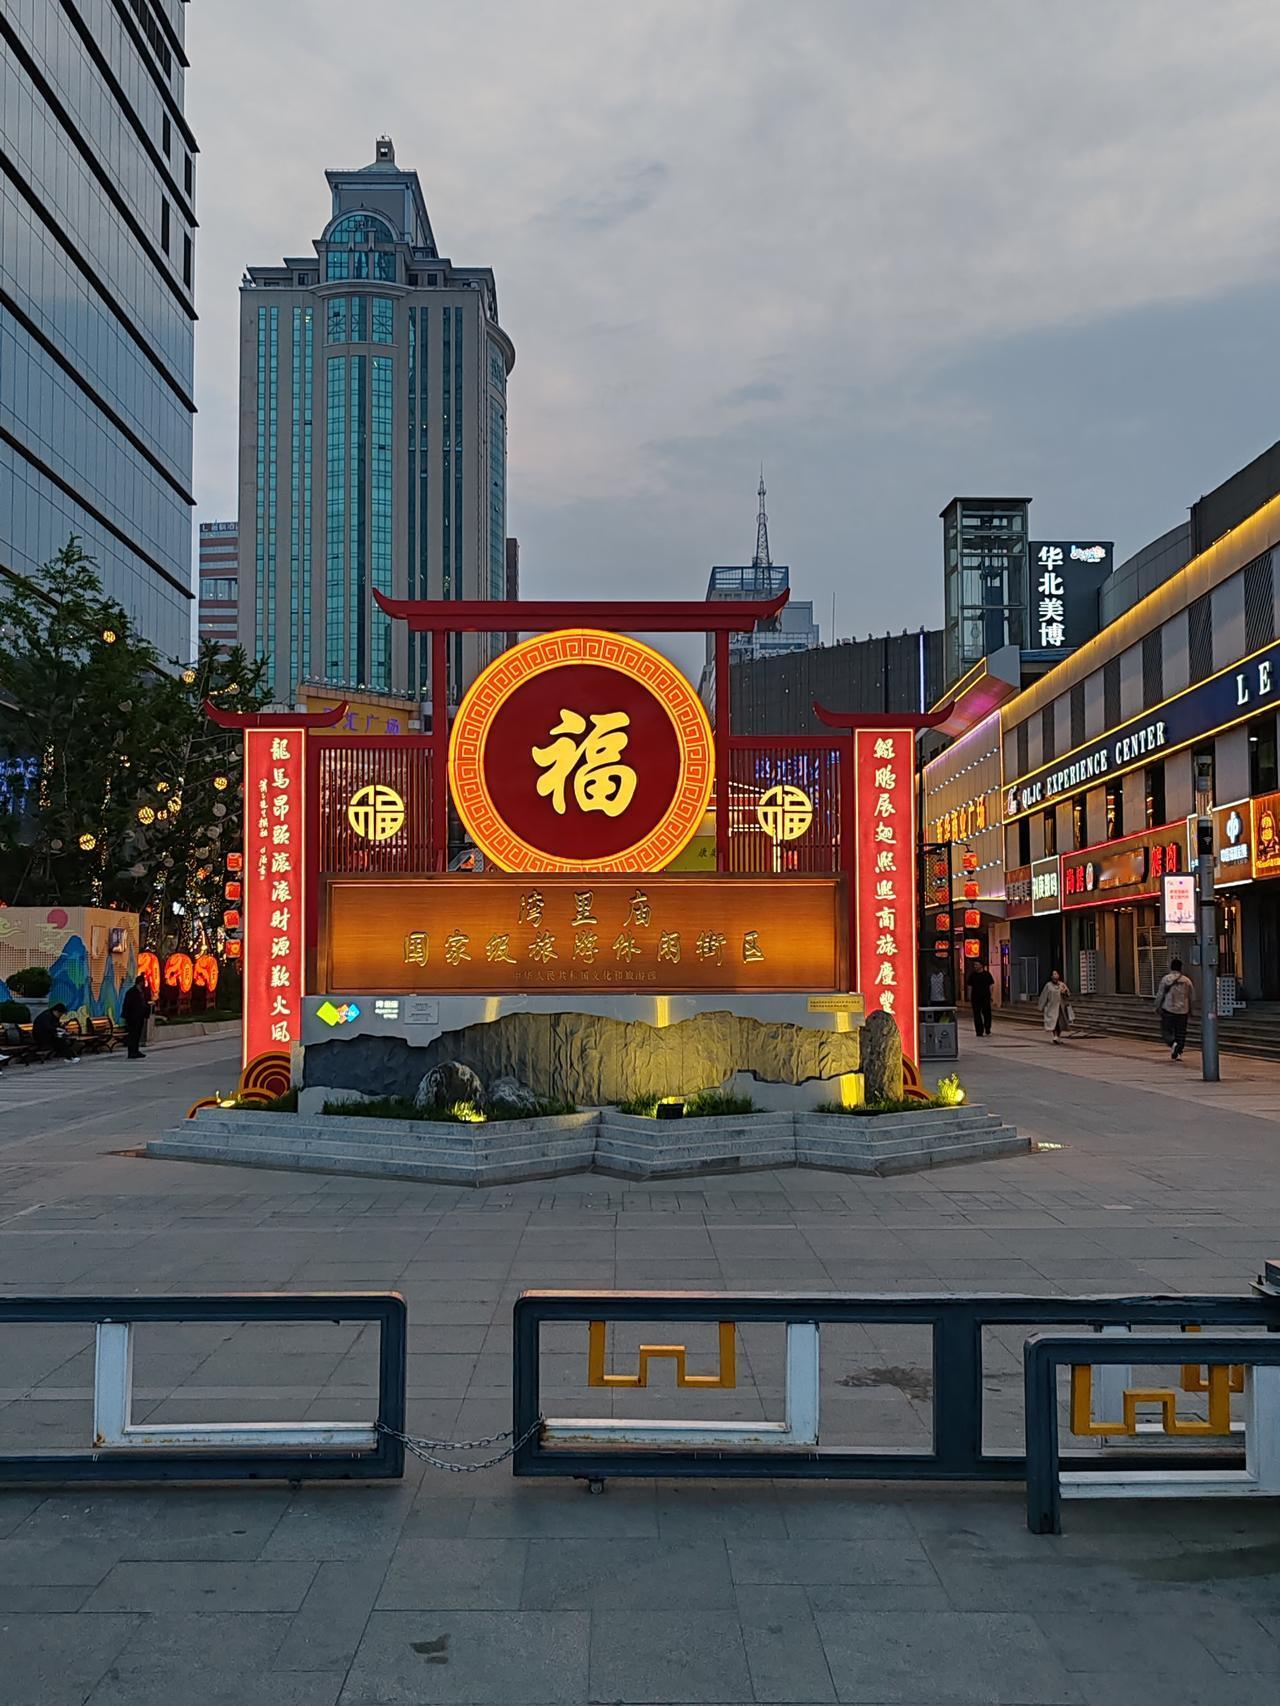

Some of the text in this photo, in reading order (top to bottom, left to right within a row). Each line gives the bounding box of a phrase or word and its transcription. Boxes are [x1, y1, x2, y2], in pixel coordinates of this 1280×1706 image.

[1038, 546, 1065, 646] 华北美博
[532, 708, 638, 818] 福
[1046, 749, 1108, 796] EXPERIENCE
[1115, 721, 1167, 765] CENTER
[518, 888, 651, 928] 湾里庙
